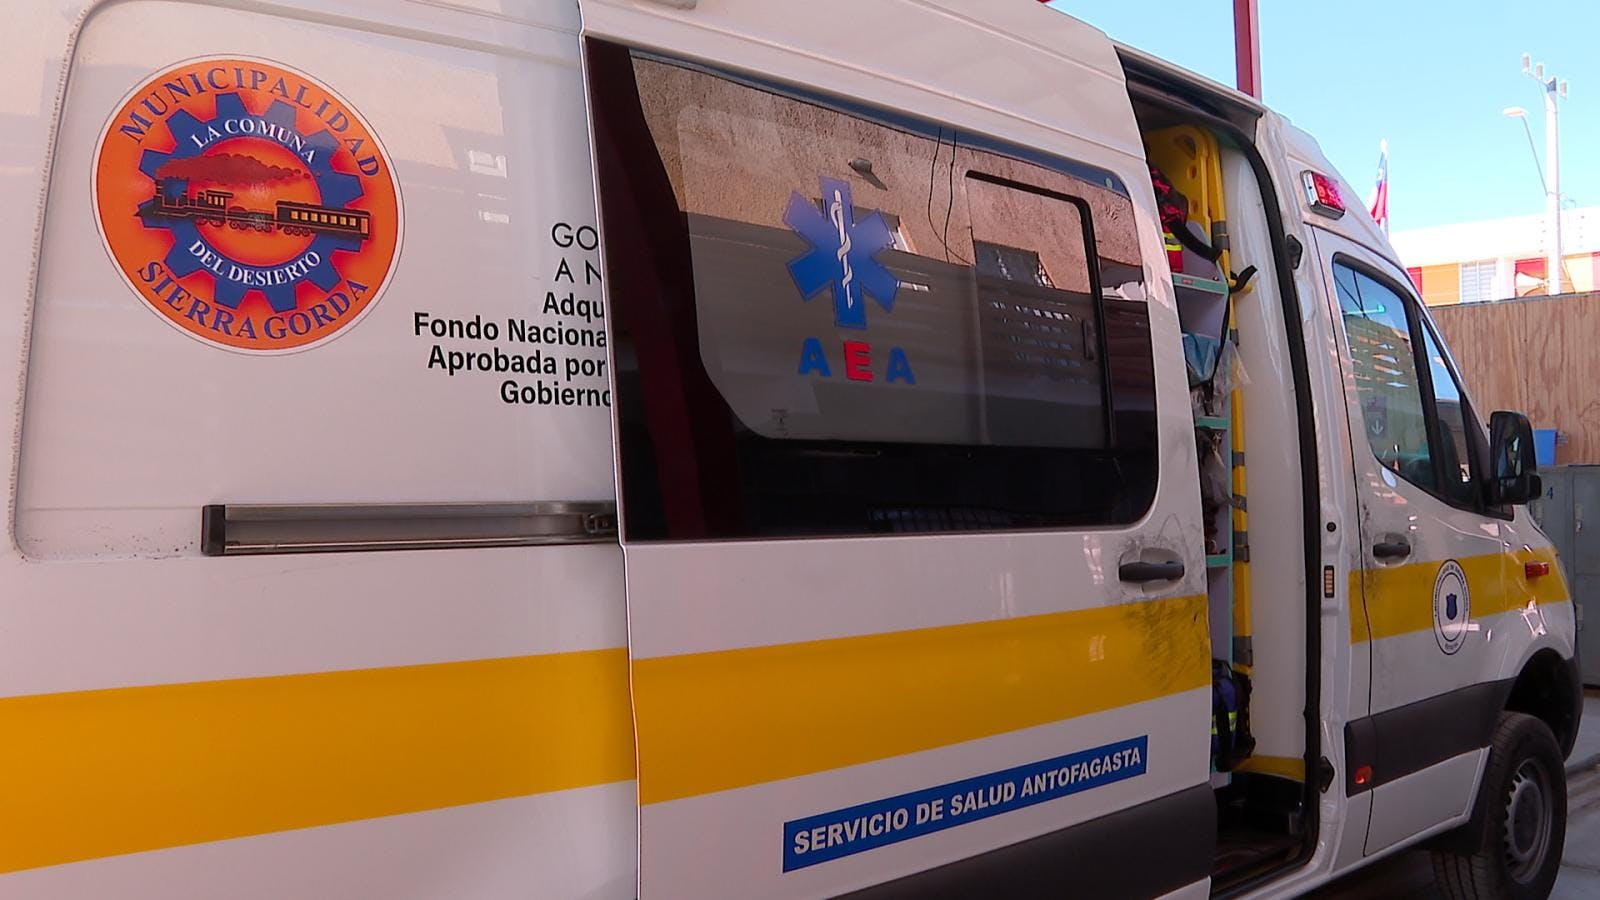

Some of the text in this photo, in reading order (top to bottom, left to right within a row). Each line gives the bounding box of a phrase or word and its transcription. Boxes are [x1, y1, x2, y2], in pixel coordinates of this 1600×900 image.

[119, 67, 380, 177] MUNICIPALIDAD
[191, 118, 316, 164] LA COMUNA
[551, 222, 599, 251] GO
[188, 240, 322, 287] DEL DESIERTO
[137, 260, 370, 341] SIERRA GORDA
[542, 291, 605, 324] Adqu
[413, 311, 608, 348] Fondo Naciona
[427, 344, 606, 382] Aprobada por
[1546, 486, 1554, 500] 4
[793, 746, 1141, 856] SERVICIO DE SALUD ANTOFAGASTA
